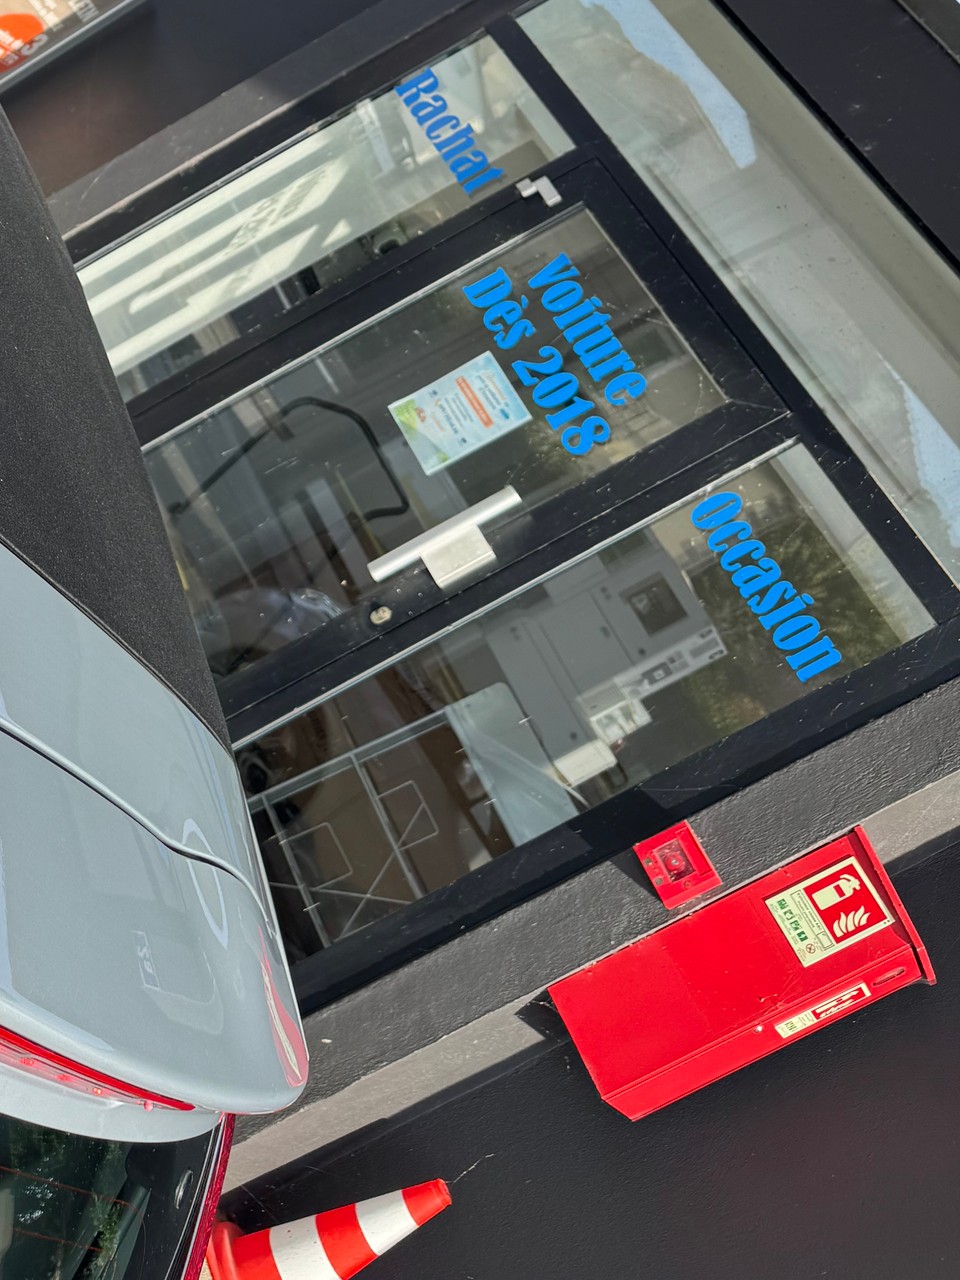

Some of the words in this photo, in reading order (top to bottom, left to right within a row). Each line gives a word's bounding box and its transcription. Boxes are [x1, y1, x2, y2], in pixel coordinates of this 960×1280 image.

[394, 67, 506, 196] Rachat
[461, 266, 537, 350] Dès
[510, 345, 612, 457] 2018
[527, 251, 647, 406] Voiture
[690, 490, 843, 684] Occasion
